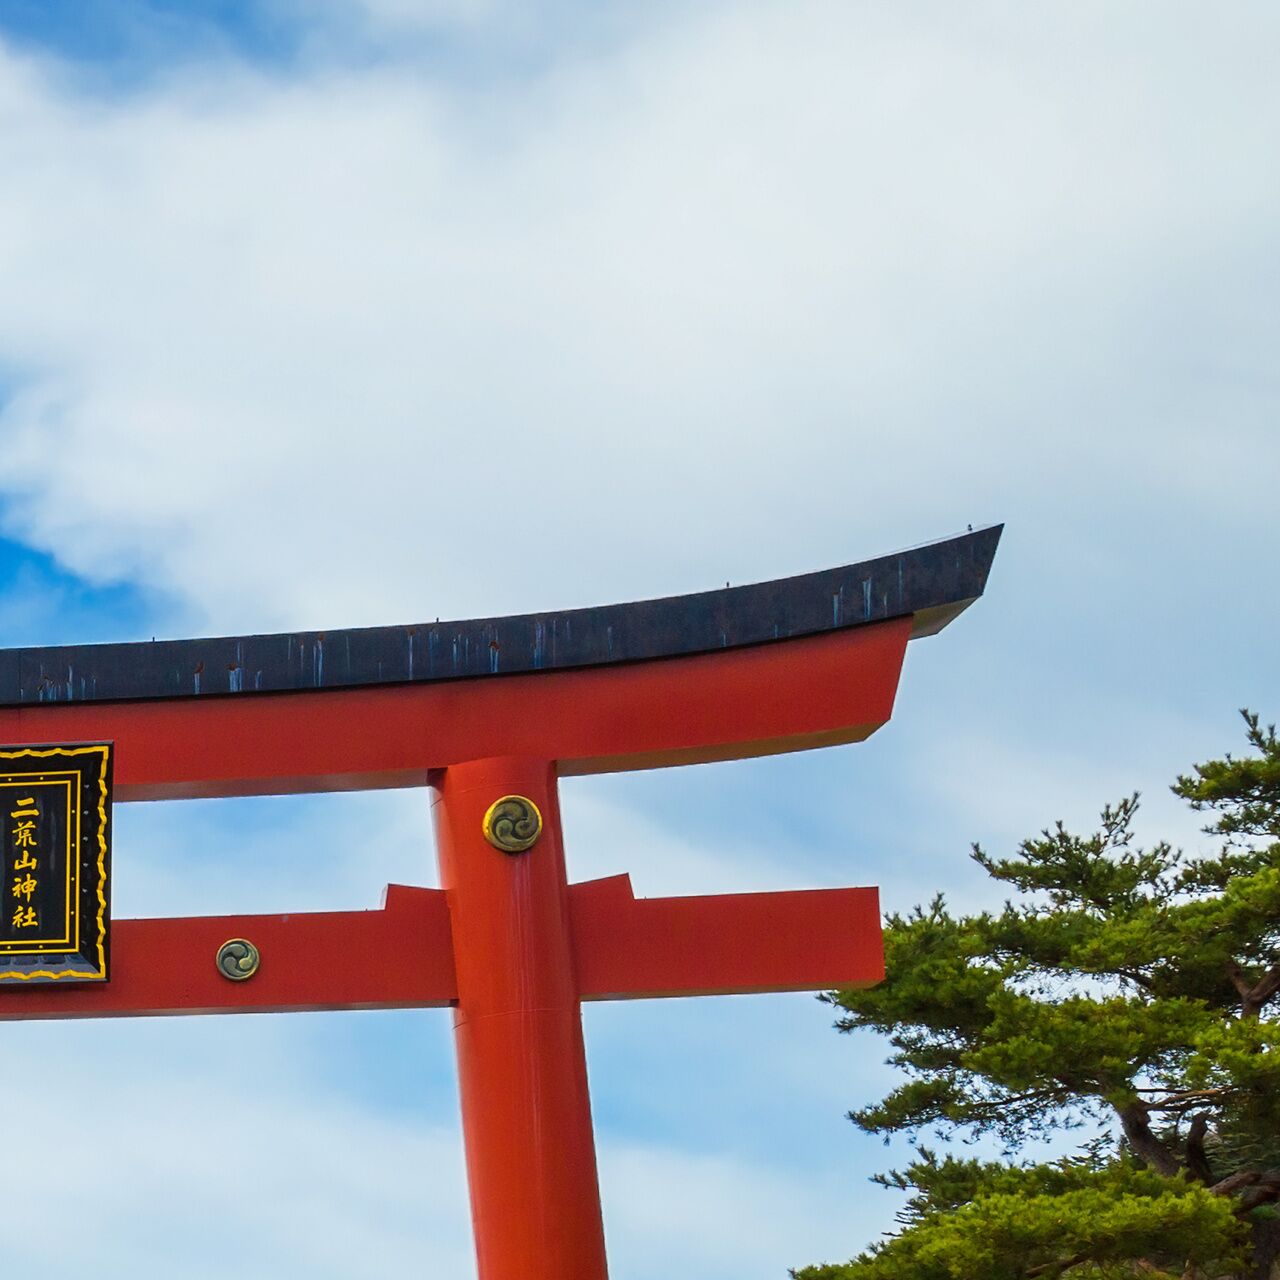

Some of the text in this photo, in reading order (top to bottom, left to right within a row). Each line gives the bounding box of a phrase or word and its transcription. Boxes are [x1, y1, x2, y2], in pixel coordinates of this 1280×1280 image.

[10, 797, 40, 929] 二荒山神社
